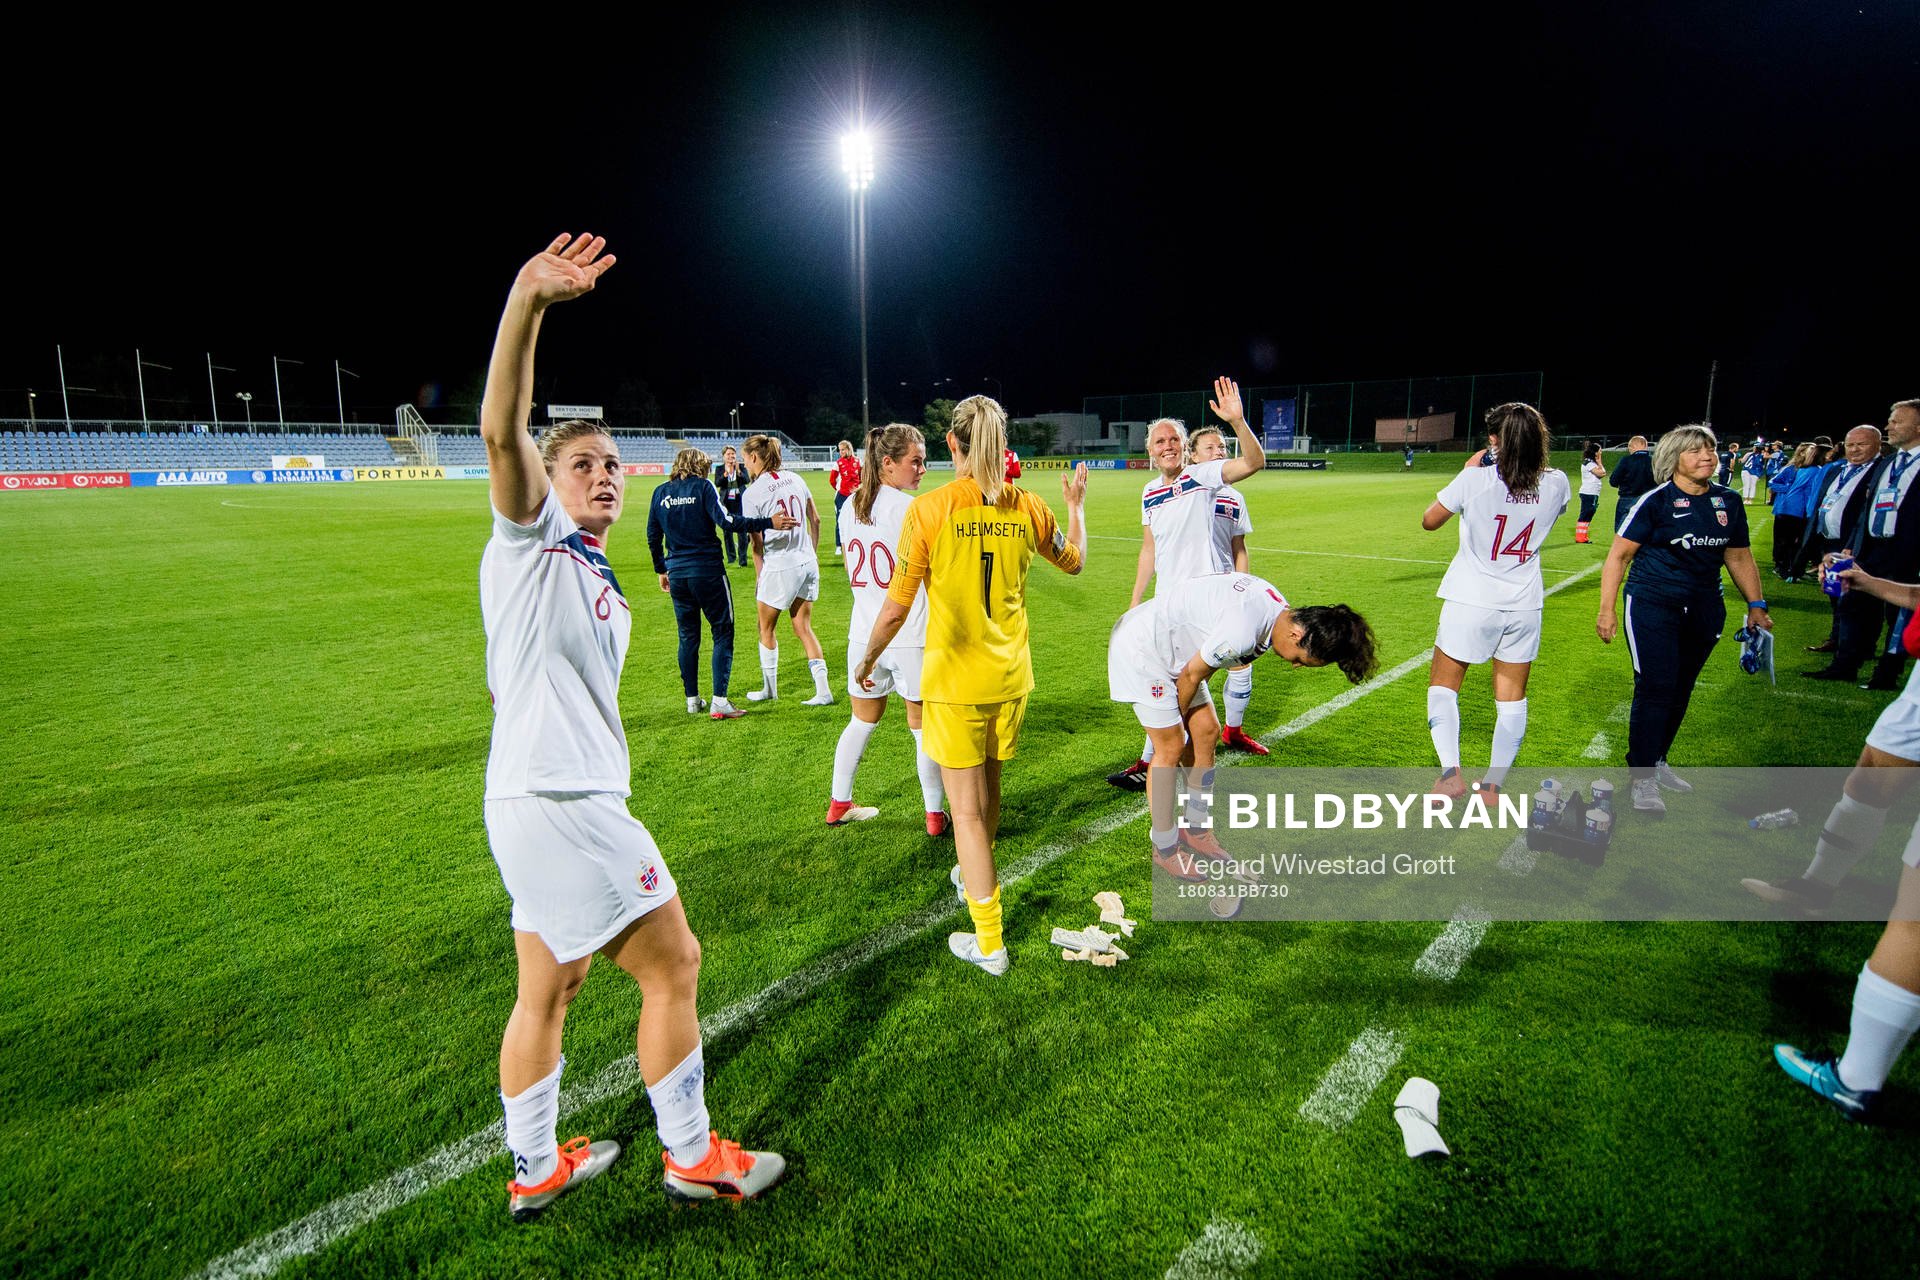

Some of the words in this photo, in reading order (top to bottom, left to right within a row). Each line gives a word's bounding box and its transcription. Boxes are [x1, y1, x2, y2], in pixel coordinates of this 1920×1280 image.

[1020, 461, 1069, 469] FORTUNA
[1097, 460, 1116, 468] AUTO
[156, 472, 188, 482] AAA
[190, 471, 228, 482] AUTO
[356, 468, 443, 480] FORTUNA
[669, 495, 697, 506] telenor
[777, 494, 803, 528] 10
[956, 521, 1027, 539] HJELMSETH
[1491, 514, 1536, 563] 14
[847, 537, 896, 590] 20
[980, 551, 995, 619] 1
[595, 585, 612, 621] 6
